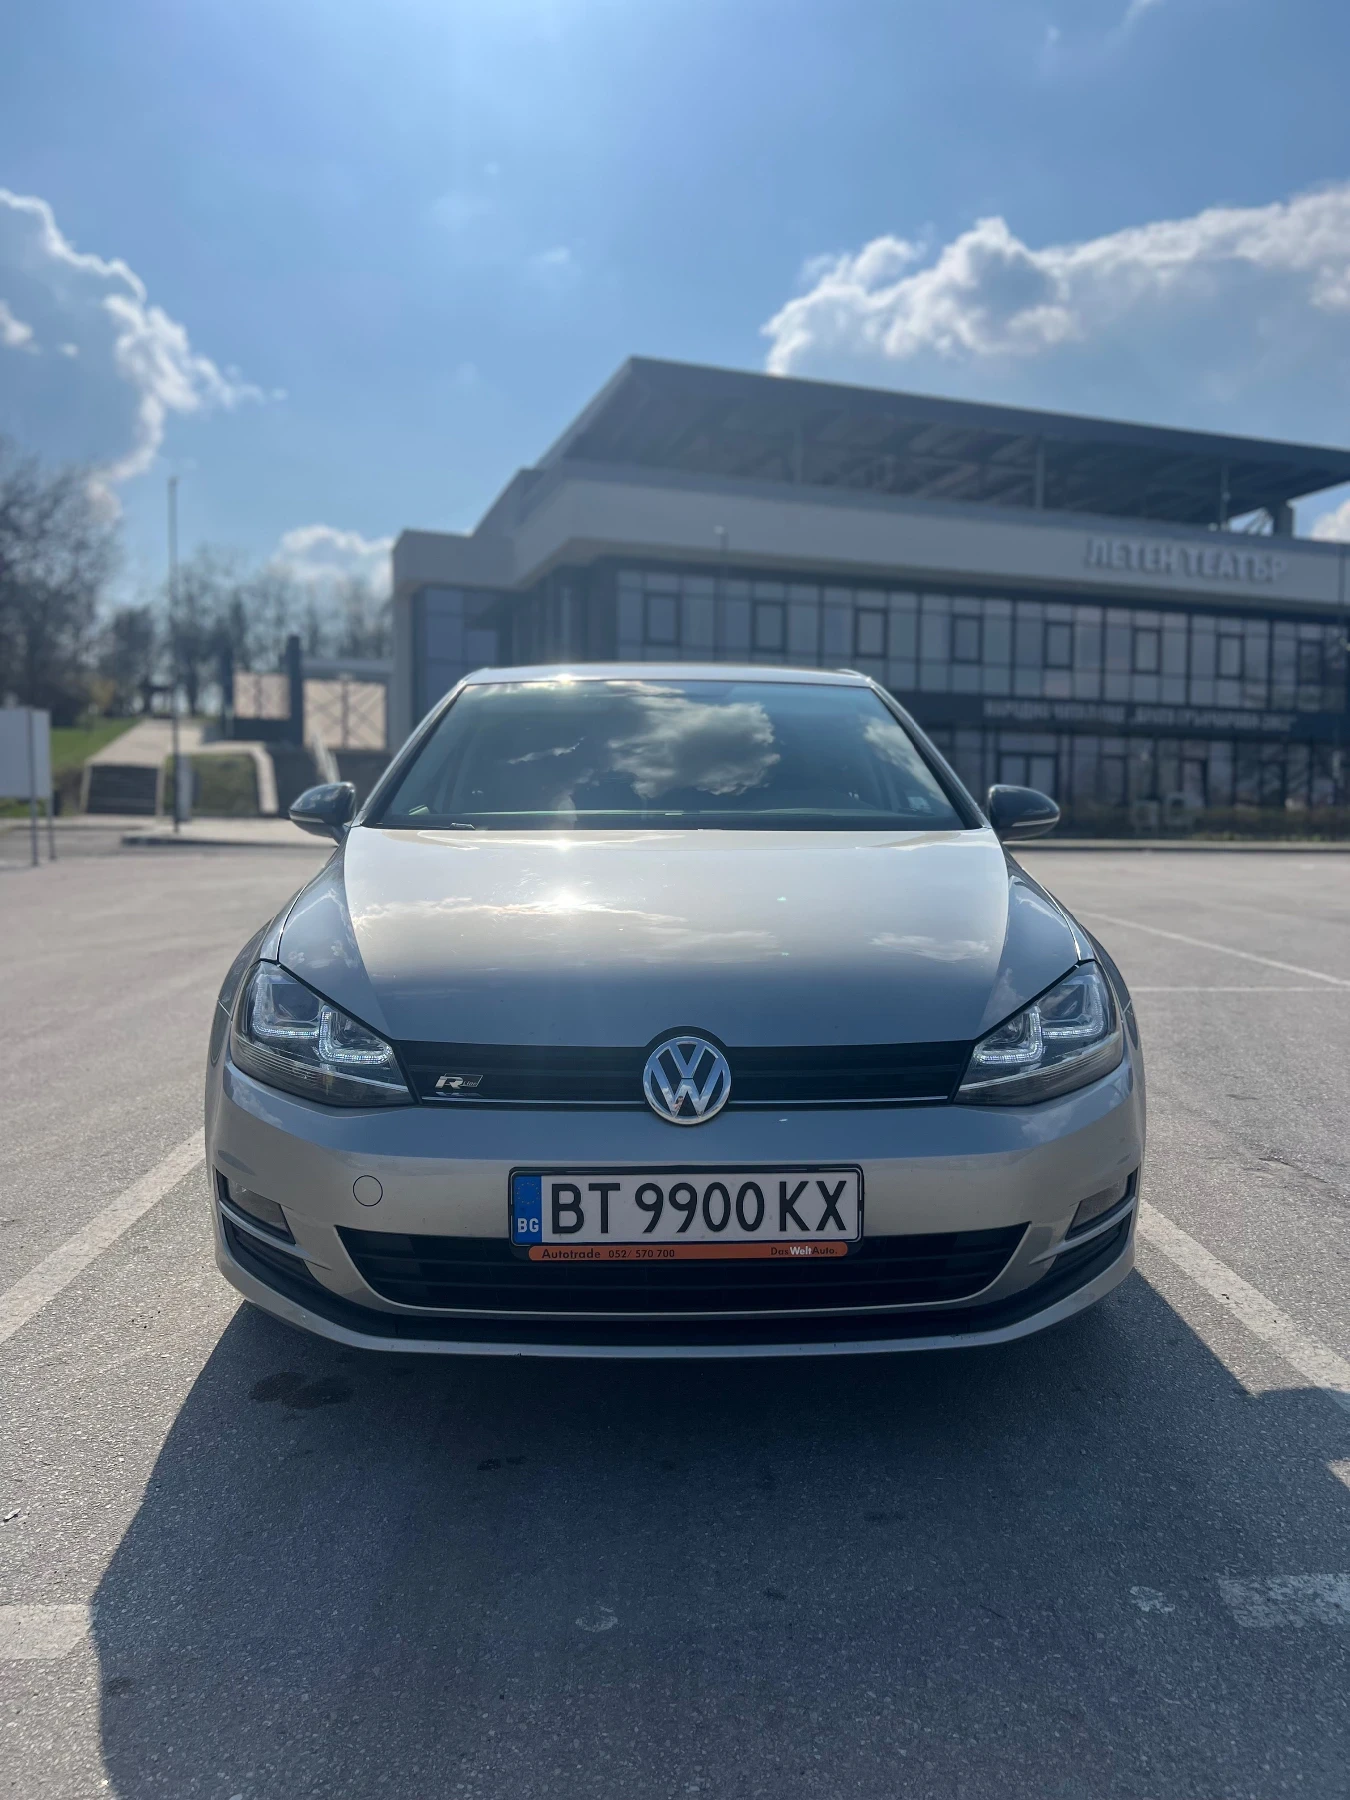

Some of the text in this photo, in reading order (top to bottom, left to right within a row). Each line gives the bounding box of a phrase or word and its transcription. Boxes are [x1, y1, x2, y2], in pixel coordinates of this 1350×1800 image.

[1086, 537, 1287, 583] ЛЕТЕН ТЕАТЪР
[646, 1037, 728, 1121] VW
[517, 1217, 539, 1233] BG
[551, 1180, 848, 1234] BT 9900 KX
[541, 1248, 601, 1260] Autotrade
[635, 1249, 654, 1259] 570
[656, 1249, 676, 1259] 700
